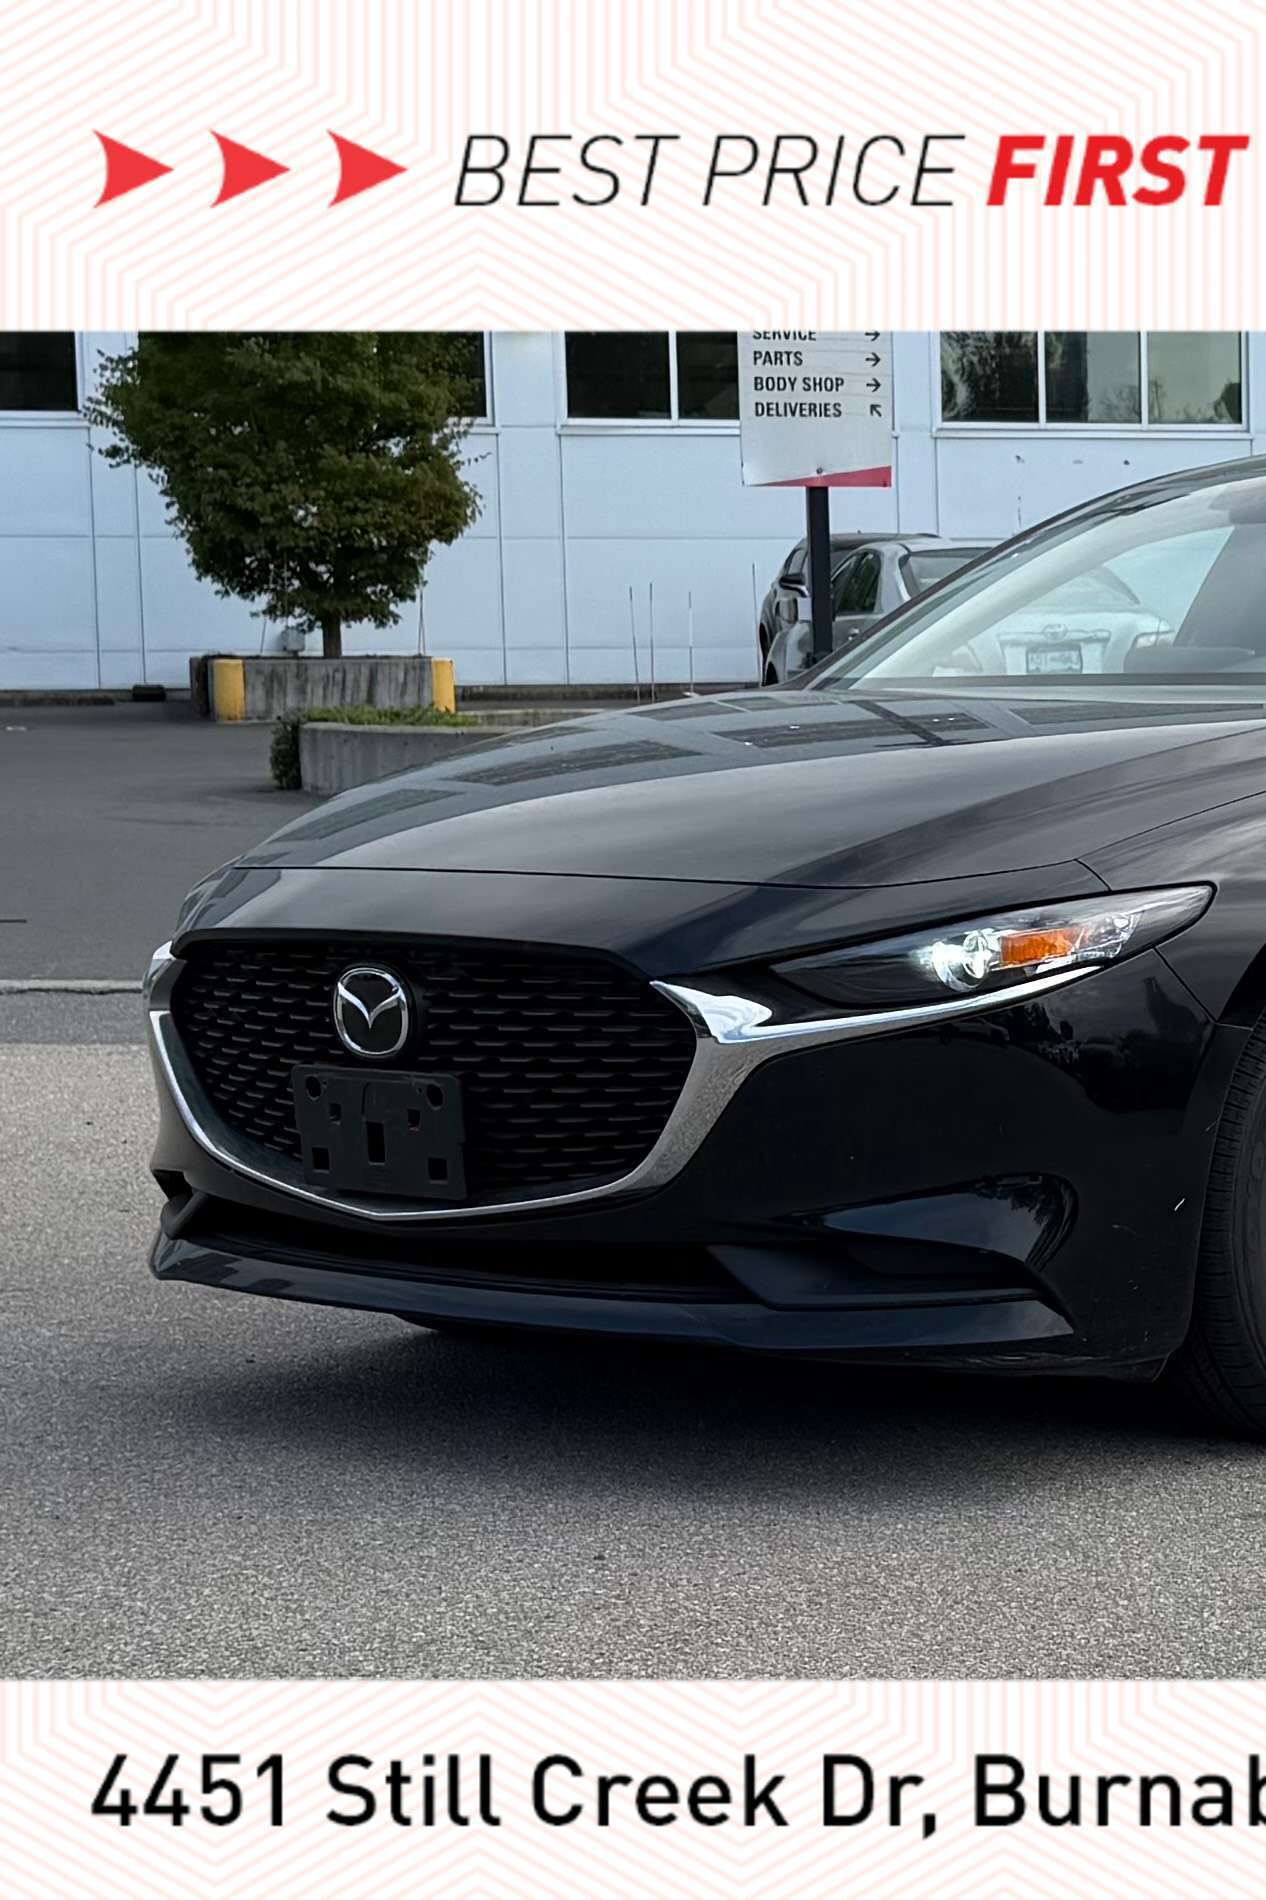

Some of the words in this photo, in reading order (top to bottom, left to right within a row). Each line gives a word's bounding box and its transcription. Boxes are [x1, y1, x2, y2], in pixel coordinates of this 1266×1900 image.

[753, 350, 803, 367] PARTS
[754, 376, 797, 392] BODY
[803, 377, 844, 393] SHOP
[754, 401, 843, 418] DELIVERIES
